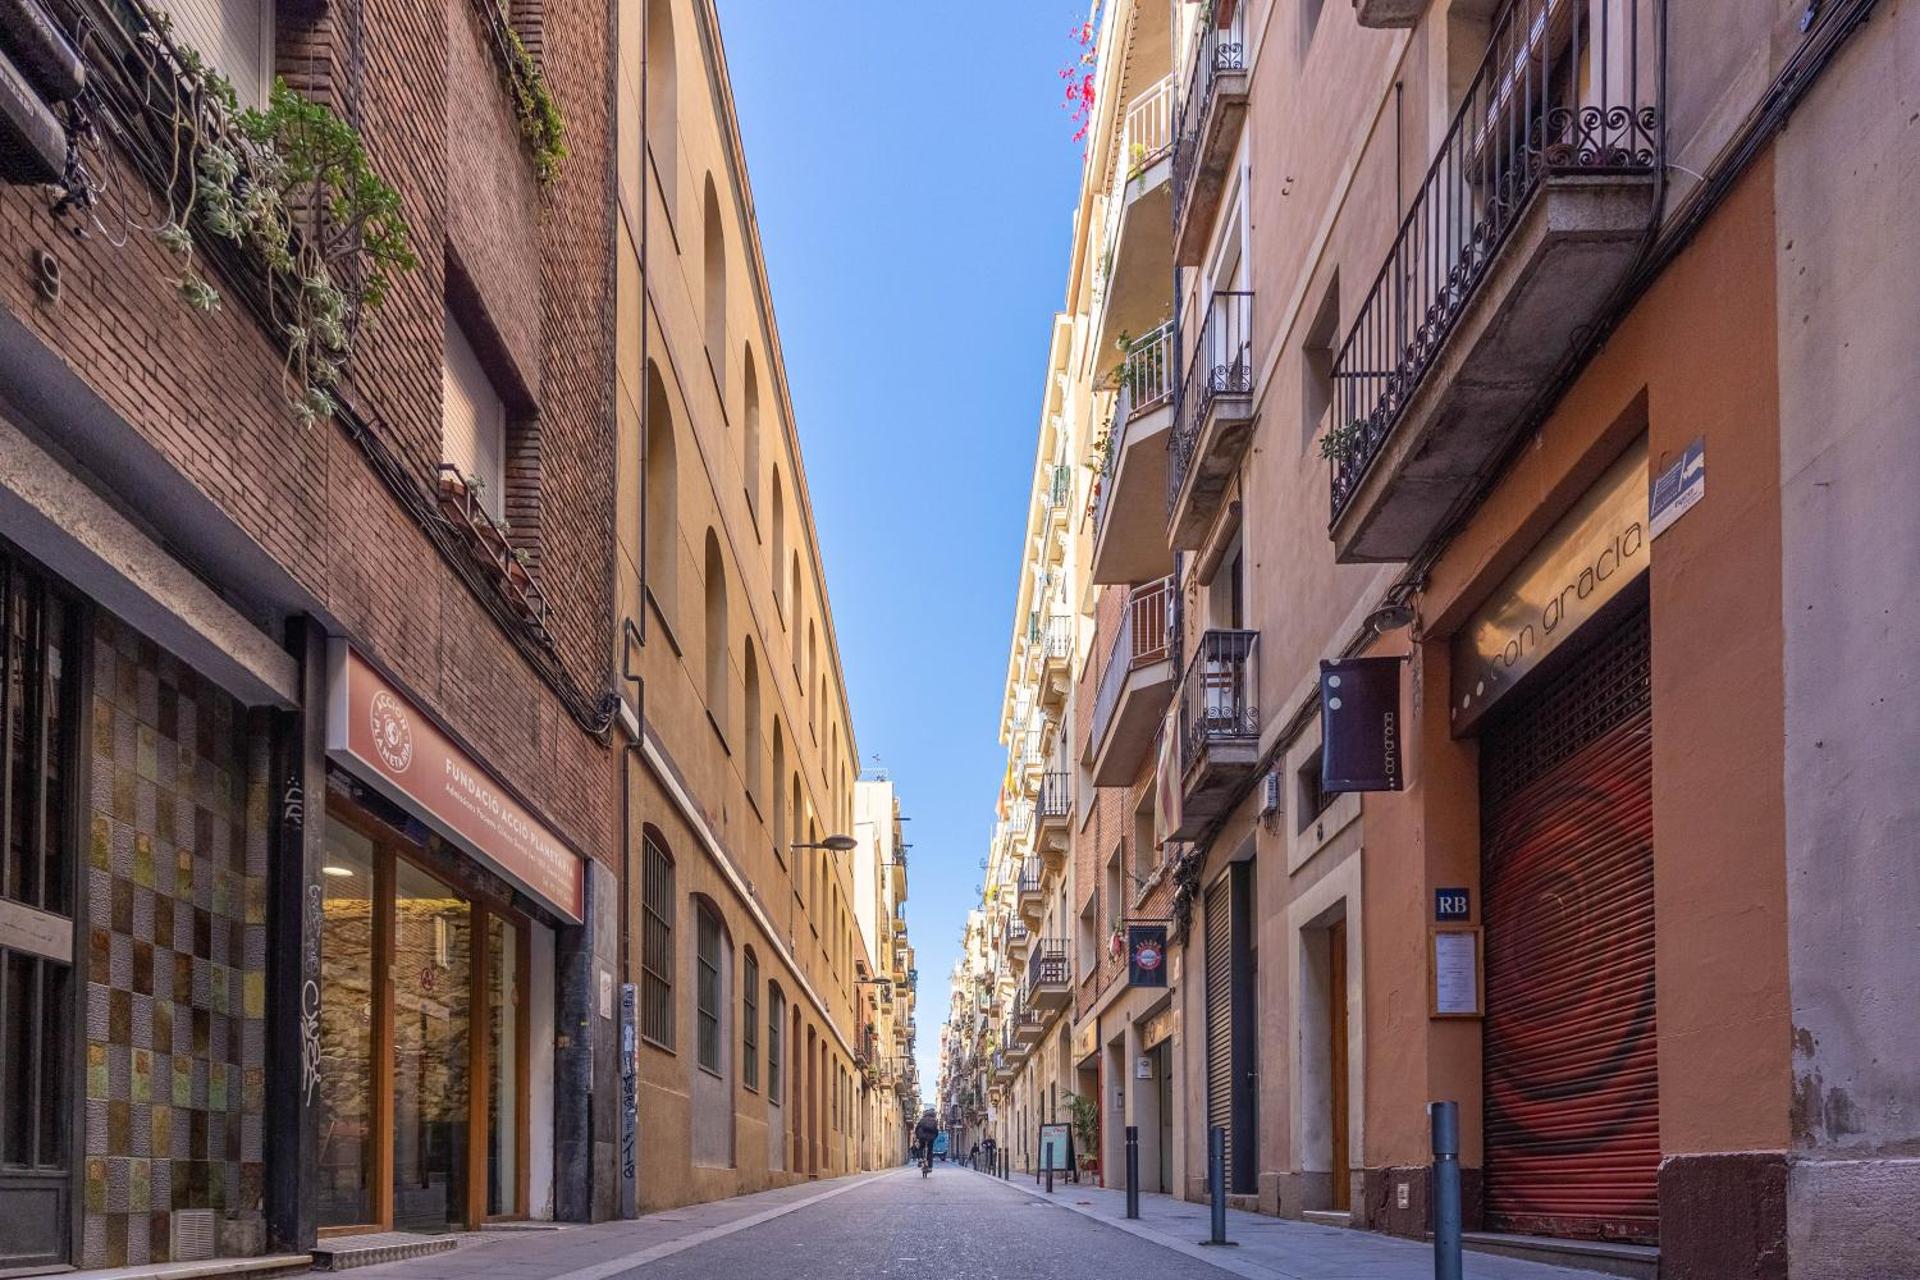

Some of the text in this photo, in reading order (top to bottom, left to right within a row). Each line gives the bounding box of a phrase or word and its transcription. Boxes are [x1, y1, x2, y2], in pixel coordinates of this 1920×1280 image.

[1490, 521, 1642, 681] con gracia
[446, 758, 499, 815] FUNDACIÓ
[501, 808, 528, 840] ACCIÓ
[1439, 896, 1467, 914] RB
